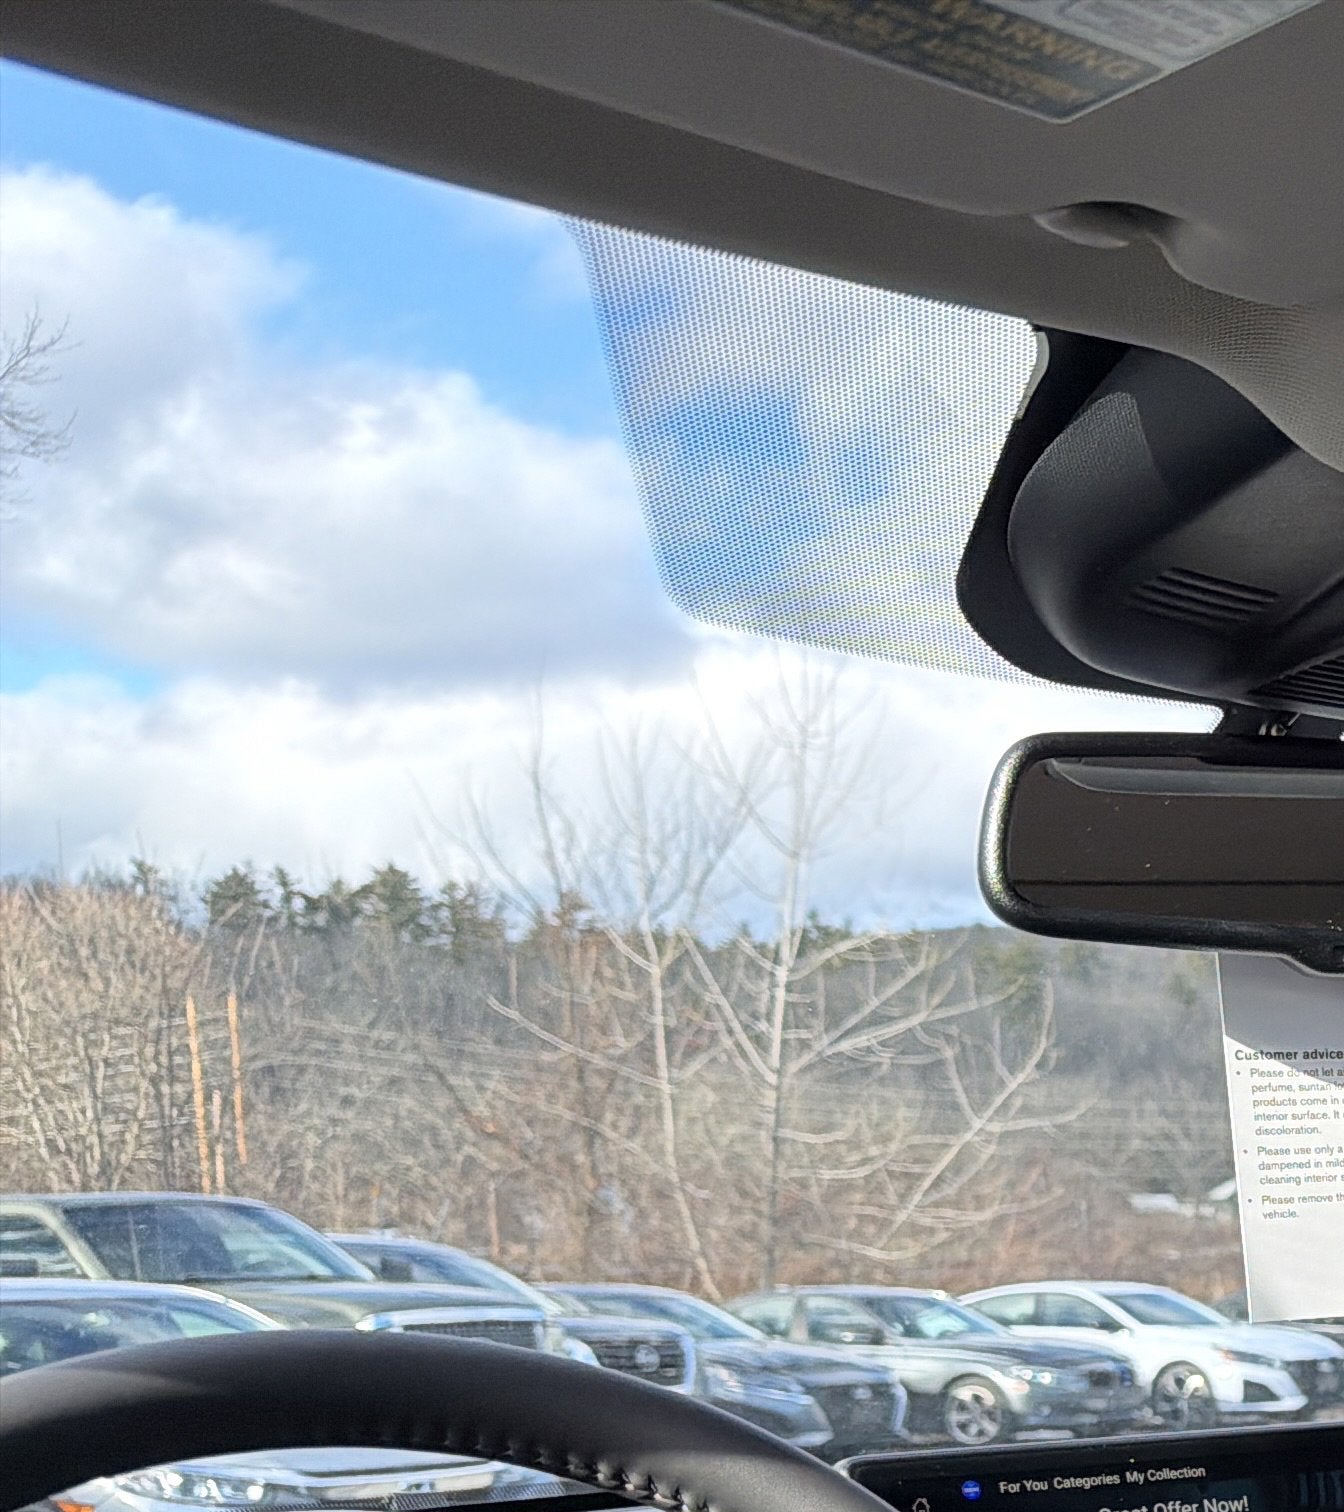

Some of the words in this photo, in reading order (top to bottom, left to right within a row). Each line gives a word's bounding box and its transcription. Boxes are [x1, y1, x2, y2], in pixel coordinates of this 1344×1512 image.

[1235, 1050, 1298, 1060] Customer
[1303, 1049, 1344, 1060] advice
[1250, 1068, 1284, 1078] Please
[1303, 1068, 1319, 1077] not
[1322, 1067, 1334, 1076] let
[1251, 1083, 1295, 1095] perfume,
[1298, 1083, 1331, 1091] suntan
[1253, 1095, 1297, 1109] products
[1331, 1094, 1339, 1104] in
[1254, 1111, 1288, 1121] interior
[1291, 1109, 1330, 1120] surface.
[1334, 1109, 1340, 1119] It
[1255, 1125, 1322, 1136] discoloration.
[1257, 1146, 1290, 1156] Please
[1294, 1147, 1311, 1155] use
[1315, 1145, 1334, 1157] only
[1259, 1161, 1311, 1172] dampened
[1314, 1160, 1322, 1168] in
[1326, 1158, 1344, 1168] mild
[1260, 1175, 1301, 1186] cleaning
[1304, 1174, 1337, 1184] interior
[1262, 1195, 1294, 1205] Please
[1298, 1194, 1333, 1204] remove
[1263, 1208, 1299, 1220] vehicle.
[999, 1480, 1021, 1495] For
[1023, 1479, 1048, 1492] You
[1053, 1473, 1120, 1491] Categories
[1126, 1470, 1145, 1485] My
[1147, 1466, 1206, 1480] Collection
